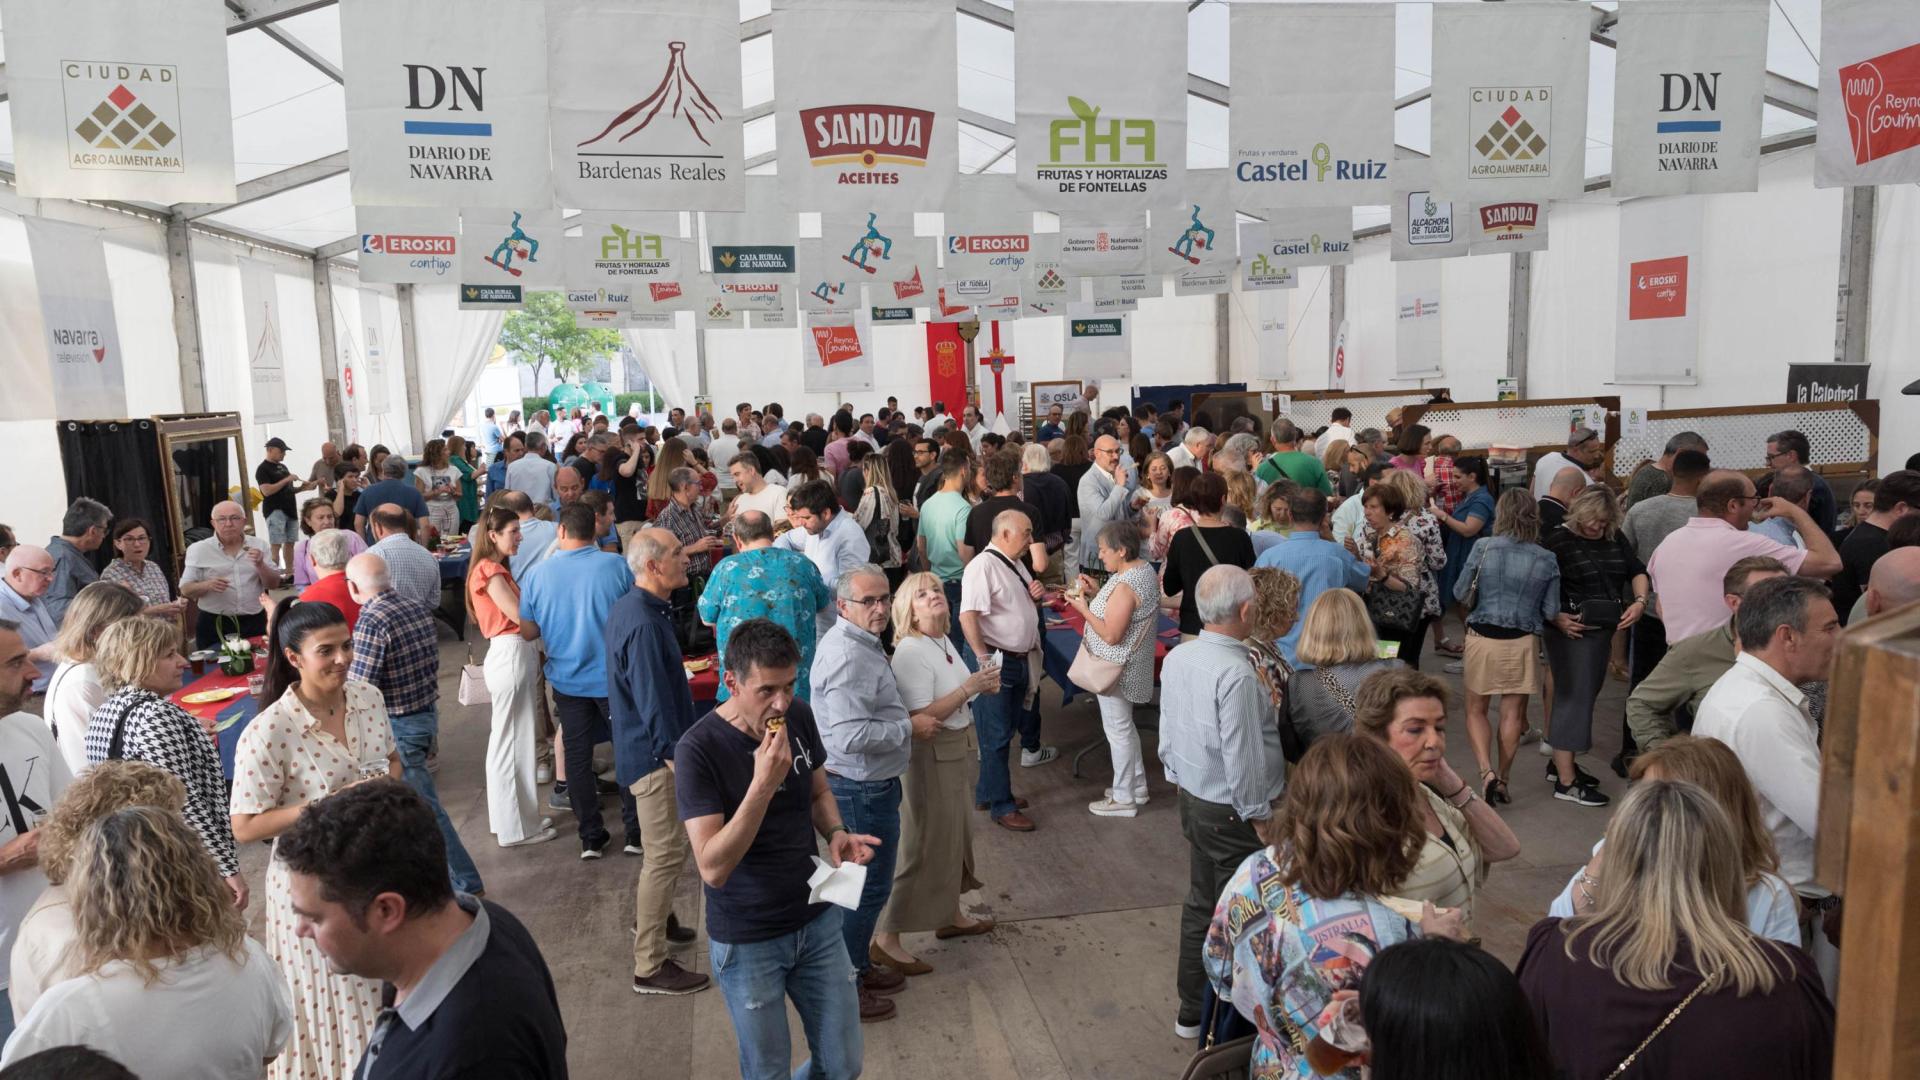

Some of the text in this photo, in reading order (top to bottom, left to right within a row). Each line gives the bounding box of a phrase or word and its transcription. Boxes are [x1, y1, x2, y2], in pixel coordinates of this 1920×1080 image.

[66, 63, 173, 83] CIUDAD
[402, 63, 487, 112] DN
[1659, 72, 1722, 112] DN
[1472, 90, 1549, 103] CIUDAD
[814, 110, 923, 149] SANDUA
[408, 145, 491, 161] DIARIO DE
[1238, 149, 1260, 157] Frutas
[1658, 141, 1718, 155] DIARIO DE
[73, 153, 182, 168] AGROALIMENTARIA
[1658, 156, 1718, 171] NAVARRA
[409, 163, 493, 181] NAVARRA
[577, 160, 727, 181] Bardenas Reales
[1037, 170, 1168, 181] FRUTAS Y HORTALIZAS
[1236, 159, 1387, 182] Castel Ruiz
[1471, 163, 1548, 176] AGROALIMENTARIA
[837, 172, 900, 185] ACEITES
[1058, 183, 1147, 193] DE FONTELLAS
[1411, 217, 1449, 227] ALCACHOFA
[1486, 206, 1533, 225] SANDUA
[1411, 226, 1449, 235] DE TUDELA
[1496, 233, 1523, 241] ACEITES
[390, 238, 451, 252] EROSKI
[972, 238, 1025, 250] EROSKI
[1273, 241, 1349, 256] Castel Ruiz
[759, 253, 784, 261] RURAL
[989, 255, 1025, 271] contigo
[410, 256, 452, 275] contigo
[1182, 279, 1208, 287] Bardenas
[1649, 274, 1678, 287] EROSKI
[568, 293, 629, 303] Castel Ruiz
[750, 294, 776, 305] contigo
[53, 328, 99, 346] Navarra
[833, 336, 854, 345] Reyno
[1053, 392, 1078, 402] OSLA
